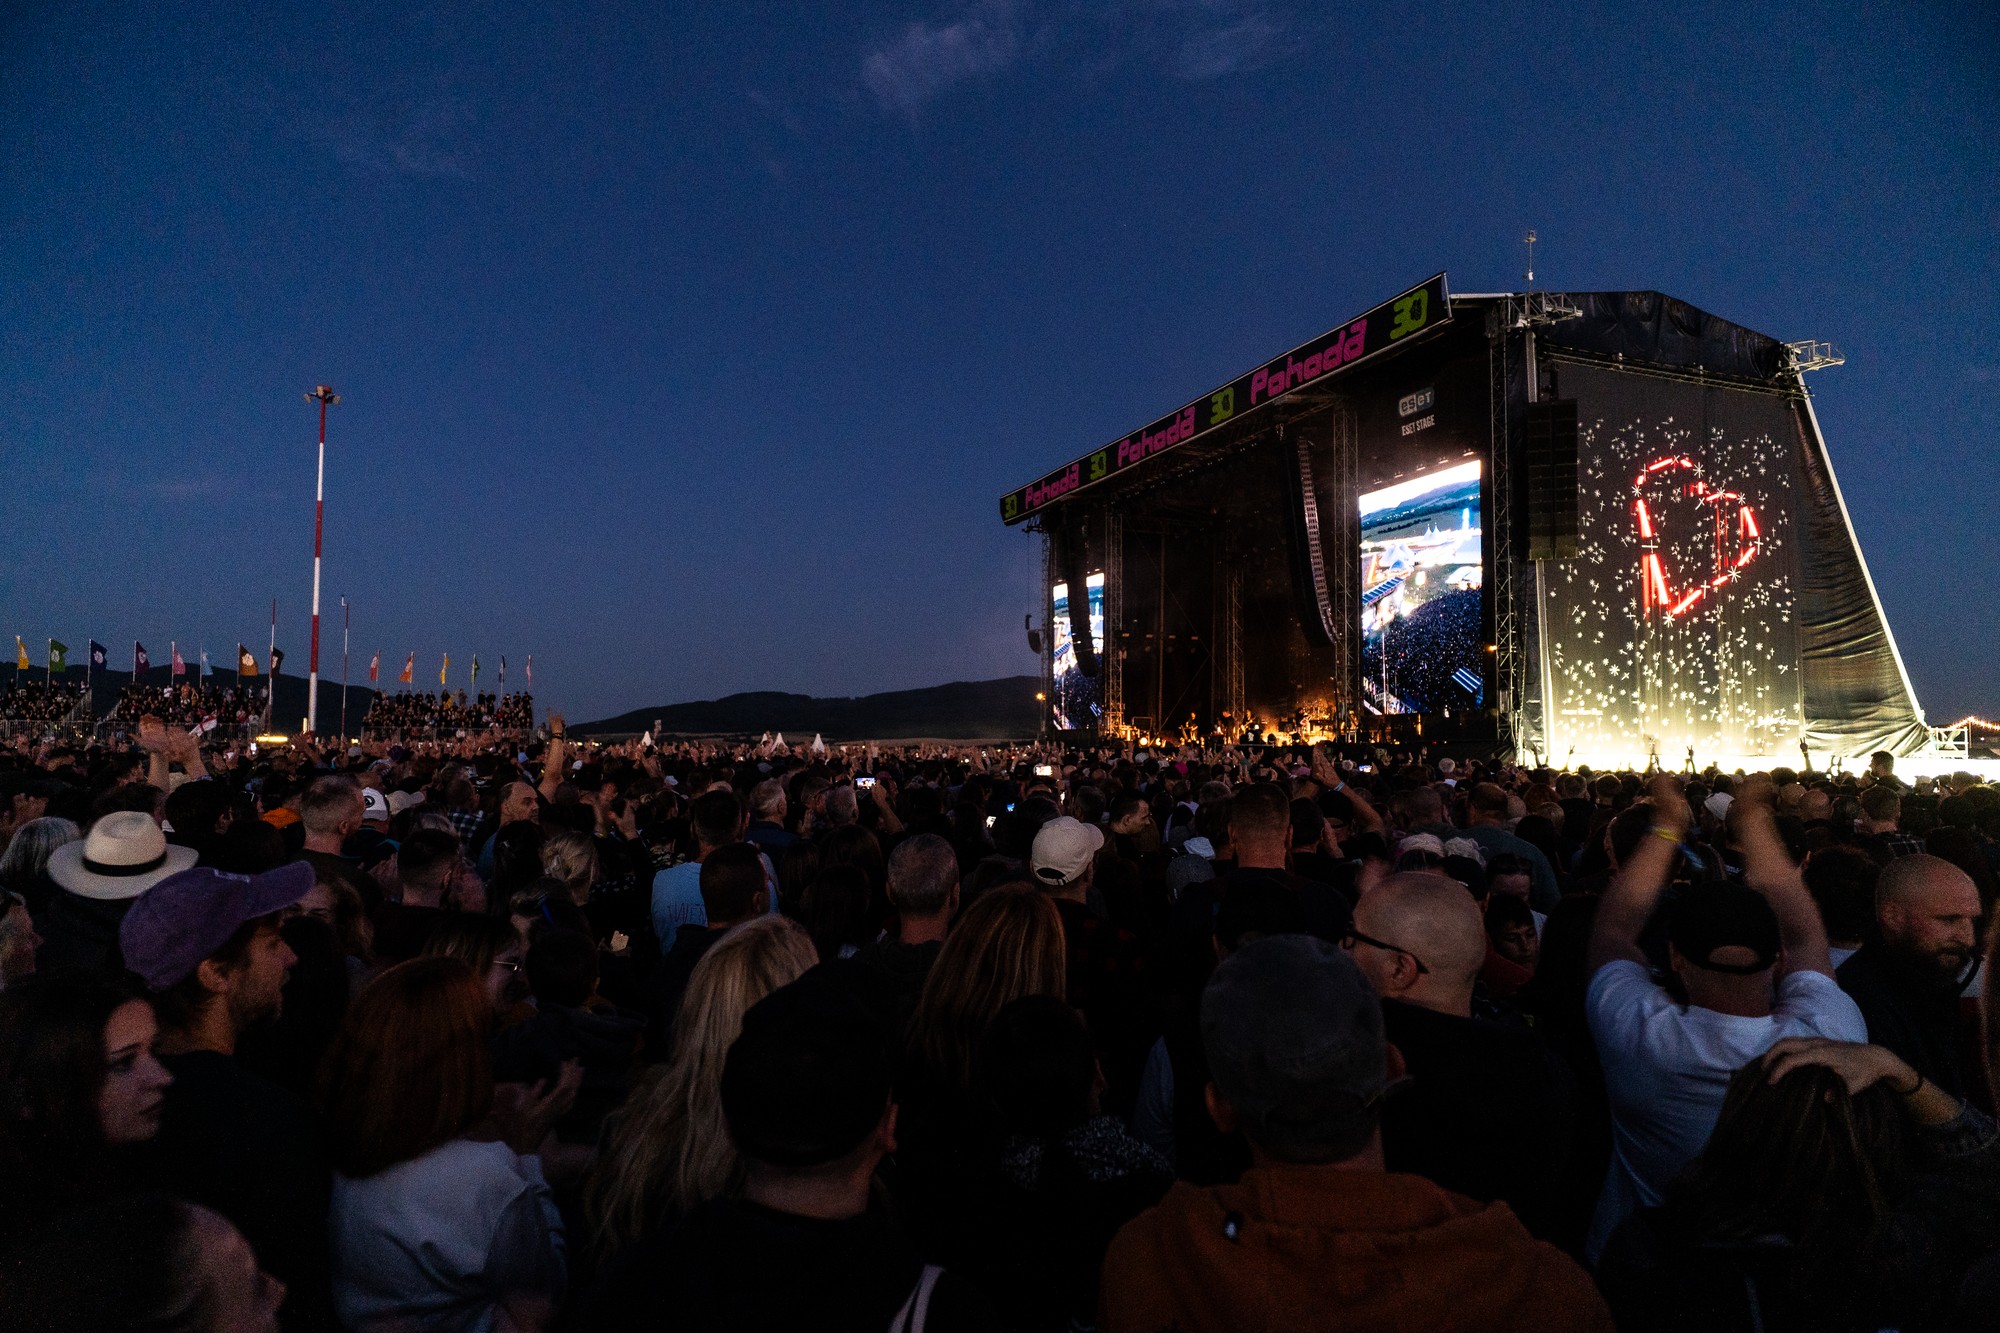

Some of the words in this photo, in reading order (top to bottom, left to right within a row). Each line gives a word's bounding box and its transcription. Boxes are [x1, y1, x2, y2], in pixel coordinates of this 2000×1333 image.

[1004, 494, 1017, 518] 30
[1025, 464, 1079, 509] Pohoda
[1090, 451, 1108, 480] 30
[1118, 407, 1196, 468] Pohoda
[1209, 386, 1235, 424] 30
[1250, 319, 1368, 404] Pohoda
[1390, 289, 1429, 341] 30
[1401, 422, 1416, 437] ESET
[1416, 414, 1436, 432] STAGE
